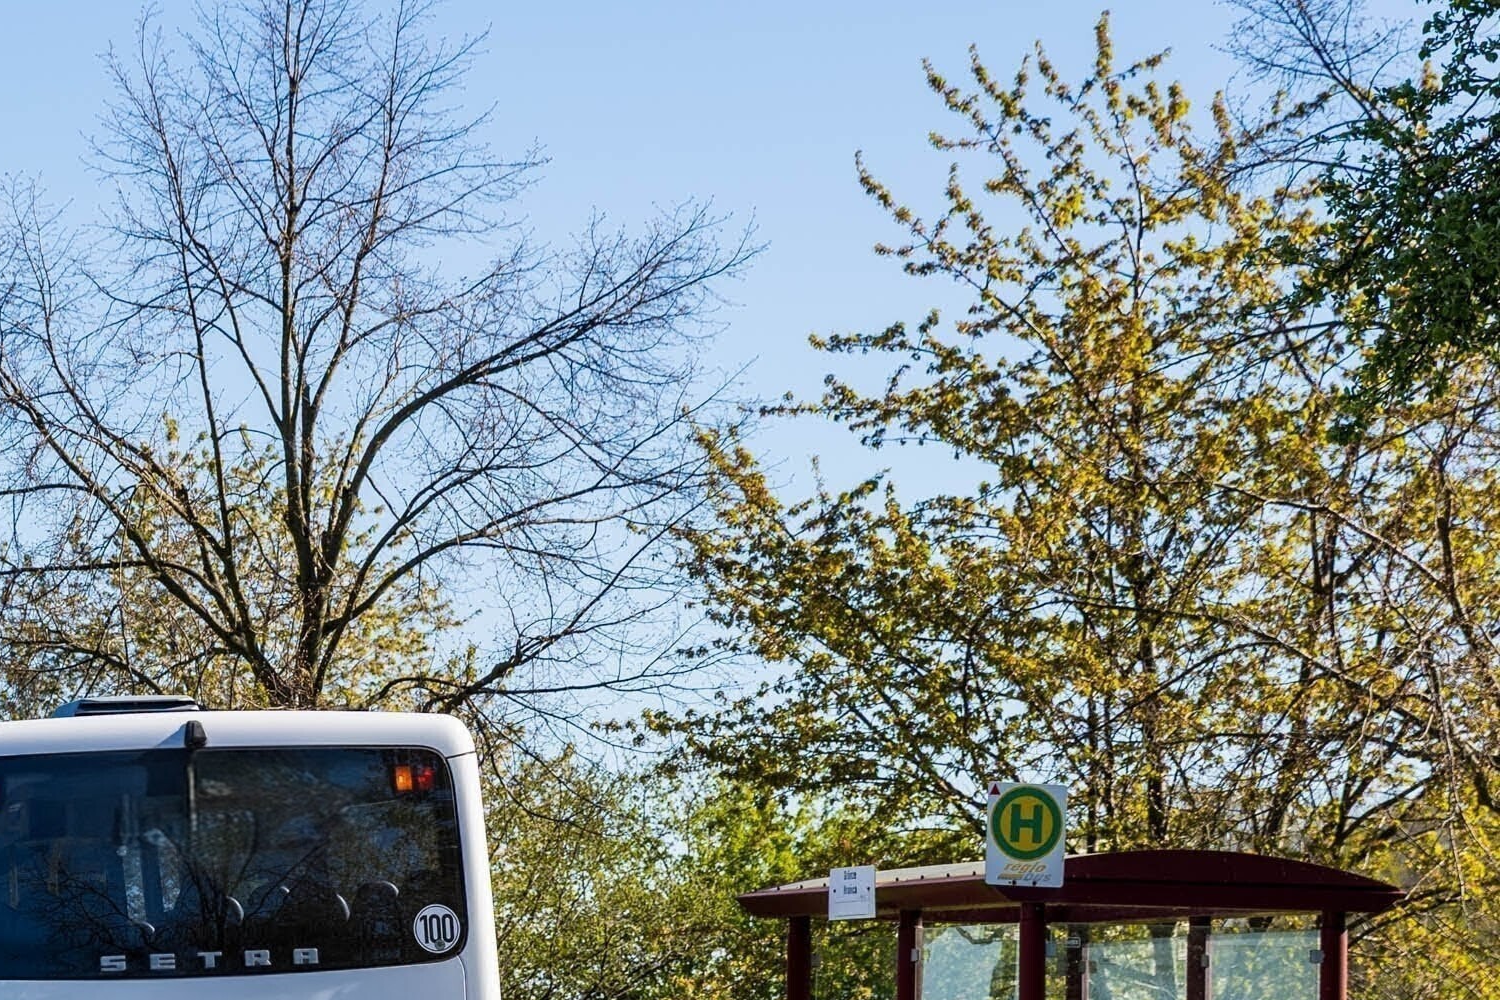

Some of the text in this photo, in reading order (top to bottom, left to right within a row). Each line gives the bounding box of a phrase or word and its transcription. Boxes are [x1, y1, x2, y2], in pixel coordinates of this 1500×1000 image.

[1009, 803, 1044, 844] H
[1003, 861, 1047, 874] regio
[419, 912, 455, 945] 100
[99, 947, 320, 972] SETRA
